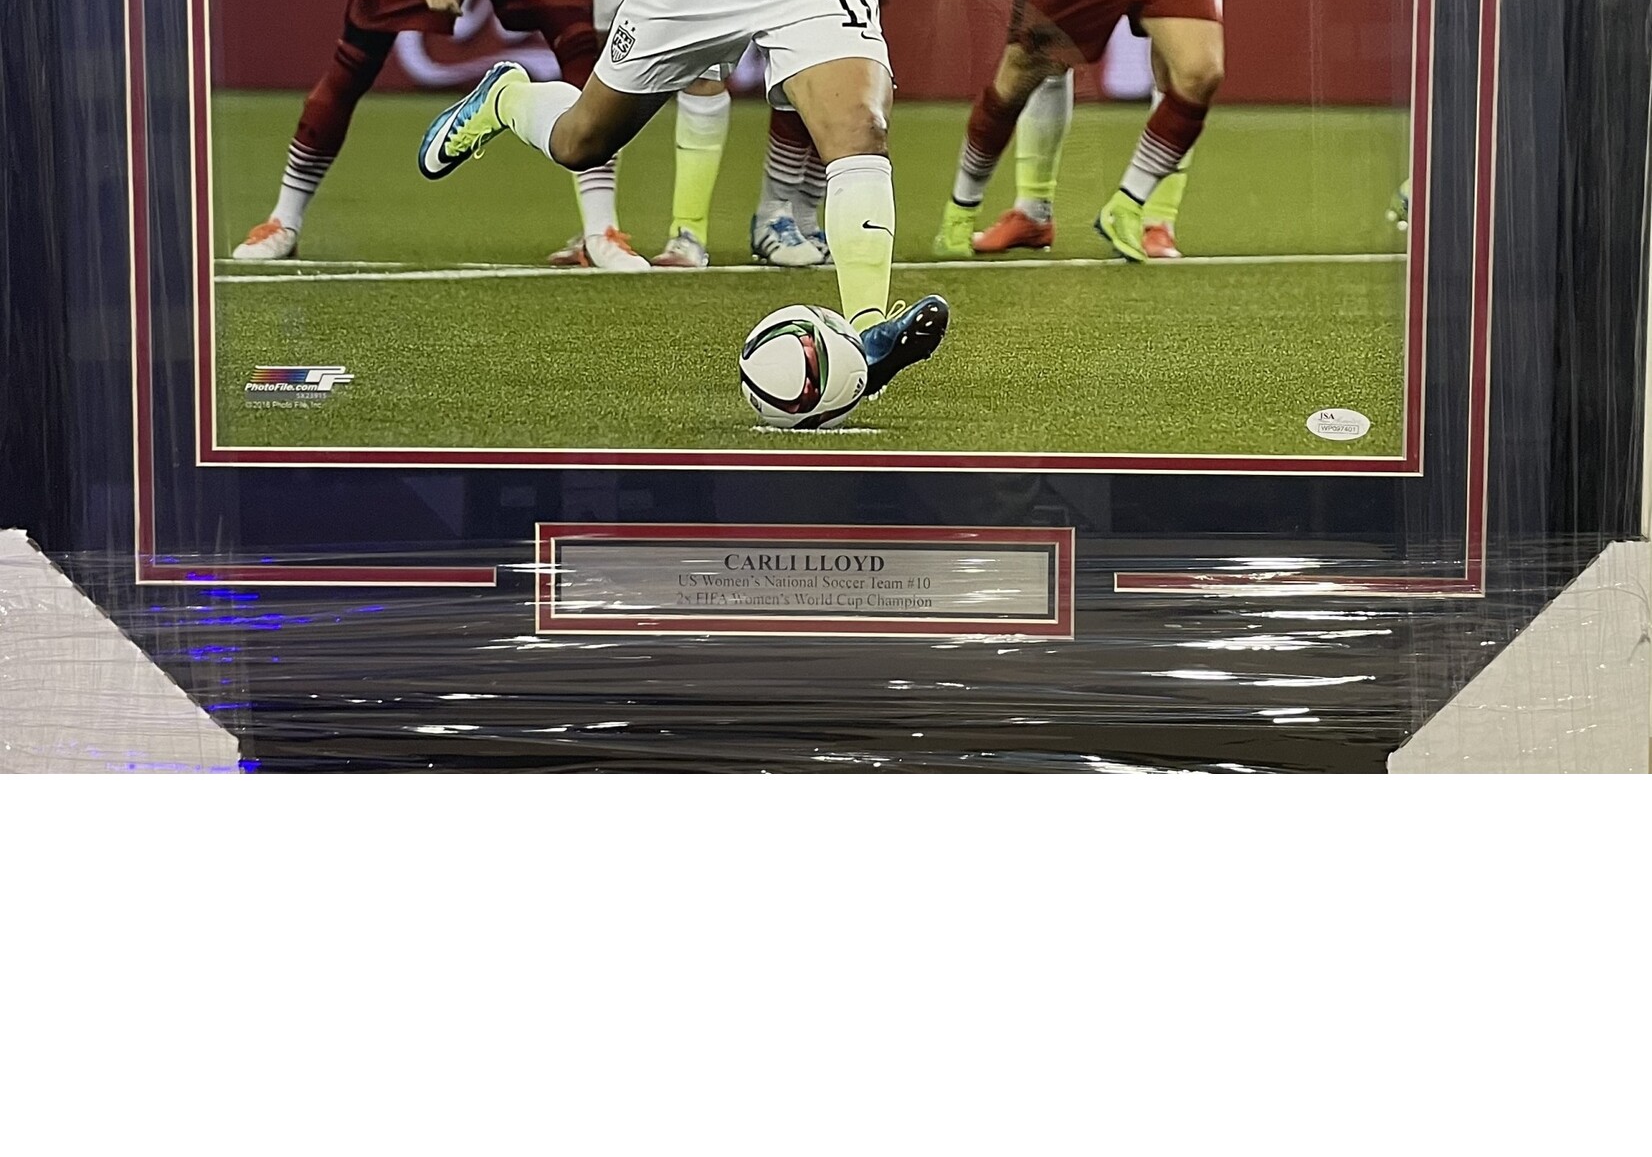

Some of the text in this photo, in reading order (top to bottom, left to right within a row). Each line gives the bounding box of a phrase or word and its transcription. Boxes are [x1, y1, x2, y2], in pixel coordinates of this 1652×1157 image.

[1318, 412, 1335, 421] JSA
[724, 553, 885, 572] CARLI LLOYD
[678, 574, 931, 590] US Women's National Soccer Team #10
[696, 591, 728, 605] FIFA
[731, 592, 791, 606] Women's
[794, 593, 833, 606] World
[836, 593, 863, 610] Cup
[866, 594, 932, 609] Champion
